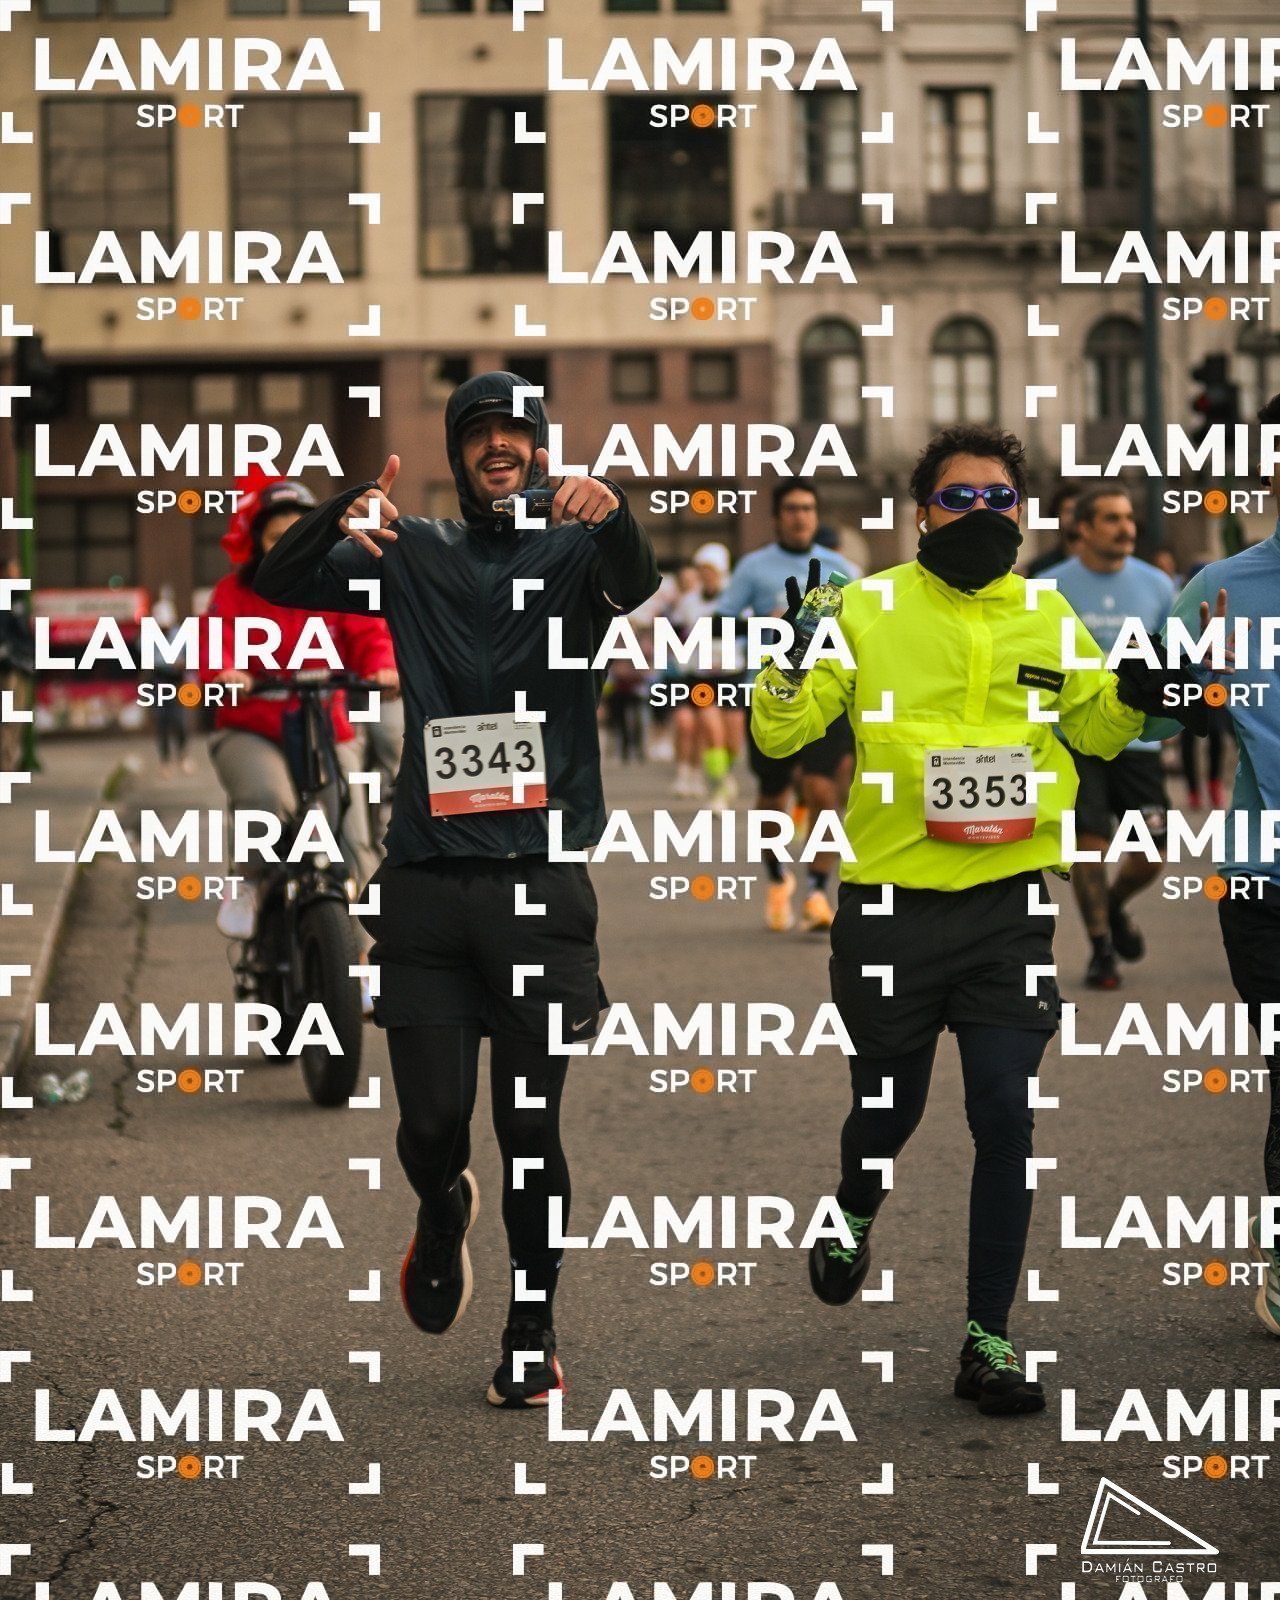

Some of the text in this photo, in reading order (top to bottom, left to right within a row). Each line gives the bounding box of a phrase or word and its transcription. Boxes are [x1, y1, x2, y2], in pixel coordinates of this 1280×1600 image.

[434, 740, 536, 780] 3343
[975, 754, 996, 764] antel
[932, 773, 1027, 810] 3353
[963, 824, 1004, 835] Maratón
